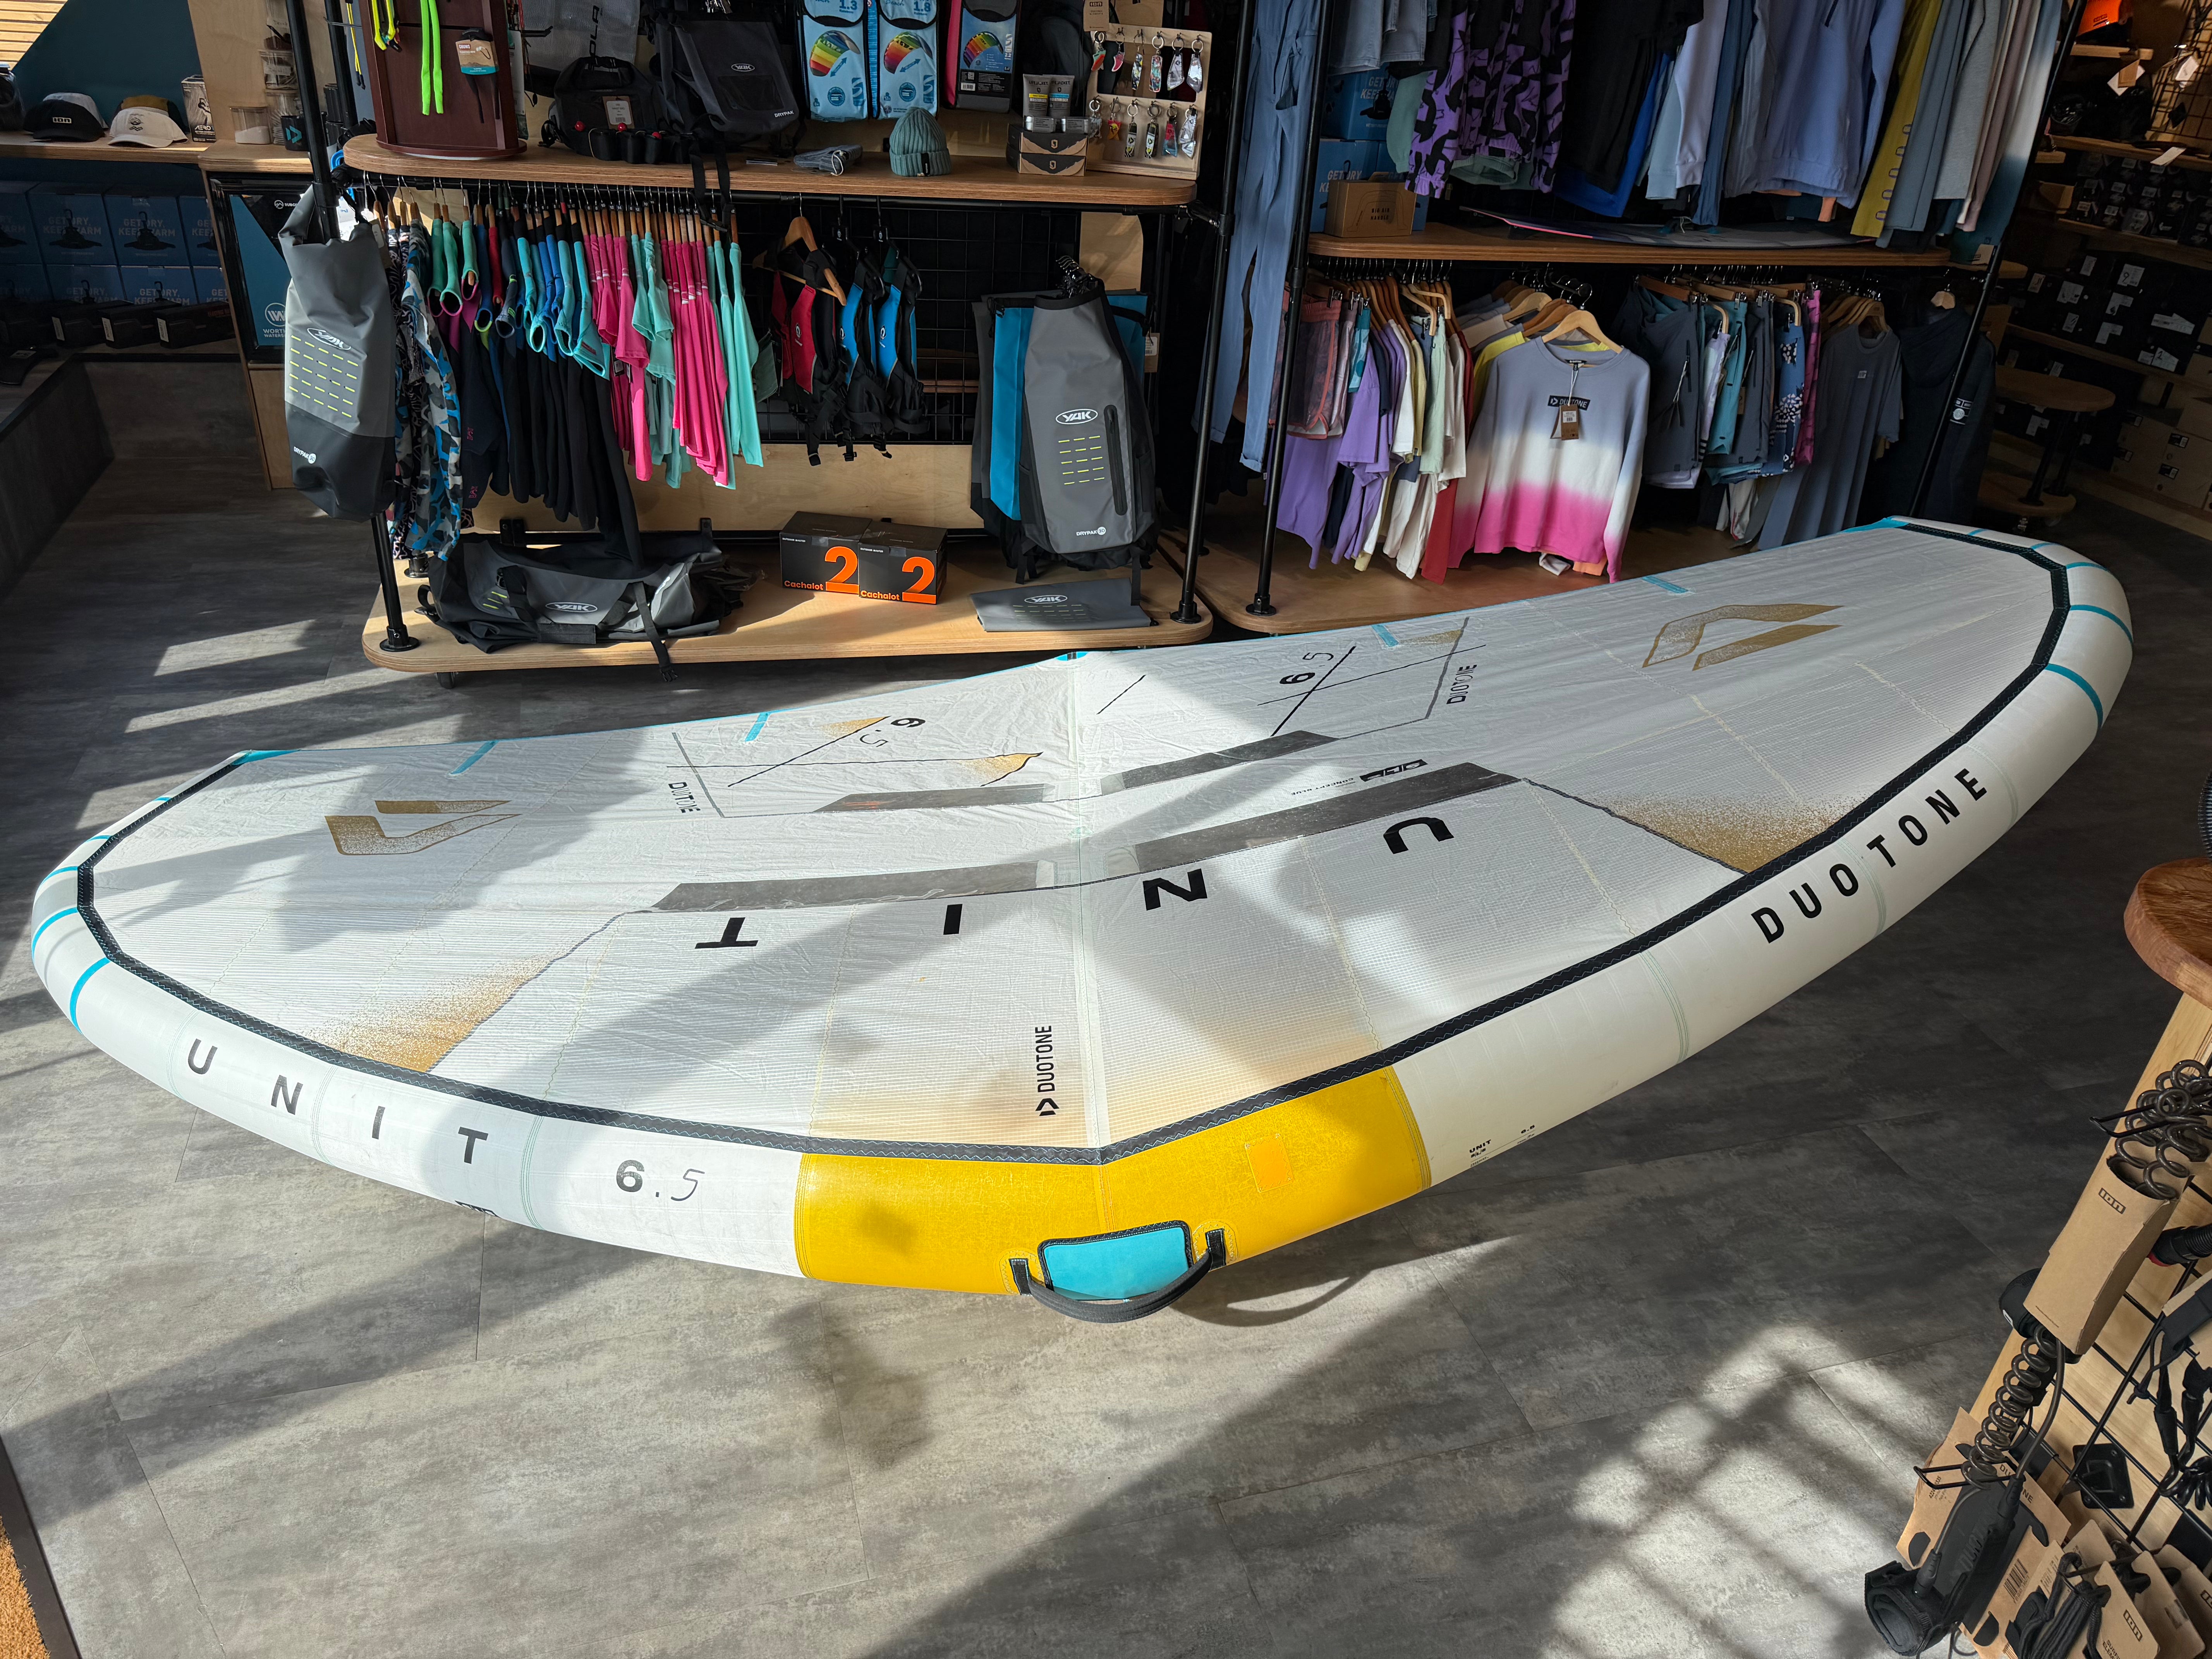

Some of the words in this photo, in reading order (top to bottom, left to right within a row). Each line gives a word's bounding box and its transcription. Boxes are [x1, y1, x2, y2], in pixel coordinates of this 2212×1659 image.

[914, 1, 931, 12] 1.8
[1328, 170, 1343, 180] GET
[1063, 411, 1093, 421] YAK
[1559, 398, 1588, 408] DUTONE
[294, 446, 309, 459] DRYPAK
[784, 580, 824, 591] Cachalot
[824, 546, 859, 594] 2
[860, 590, 900, 601] Cachalot
[902, 556, 936, 605] 2
[555, 603, 590, 612] YAK
[1279, 652, 1334, 684] 6.5
[1446, 664, 1477, 705] DUOTONE
[859, 717, 926, 748] 6.5
[668, 781, 701, 813] DUOTONE
[1315, 778, 1354, 790] CONCEPT
[1751, 768, 1988, 944] DUOTONE
[1036, 1025, 1053, 1092] DUOTONE
[187, 1038, 489, 1164] UNIT
[615, 1159, 705, 1202] 6.5
[1469, 1139, 1491, 1153] UNIT
[1999, 1463, 2034, 1504] DUNE
